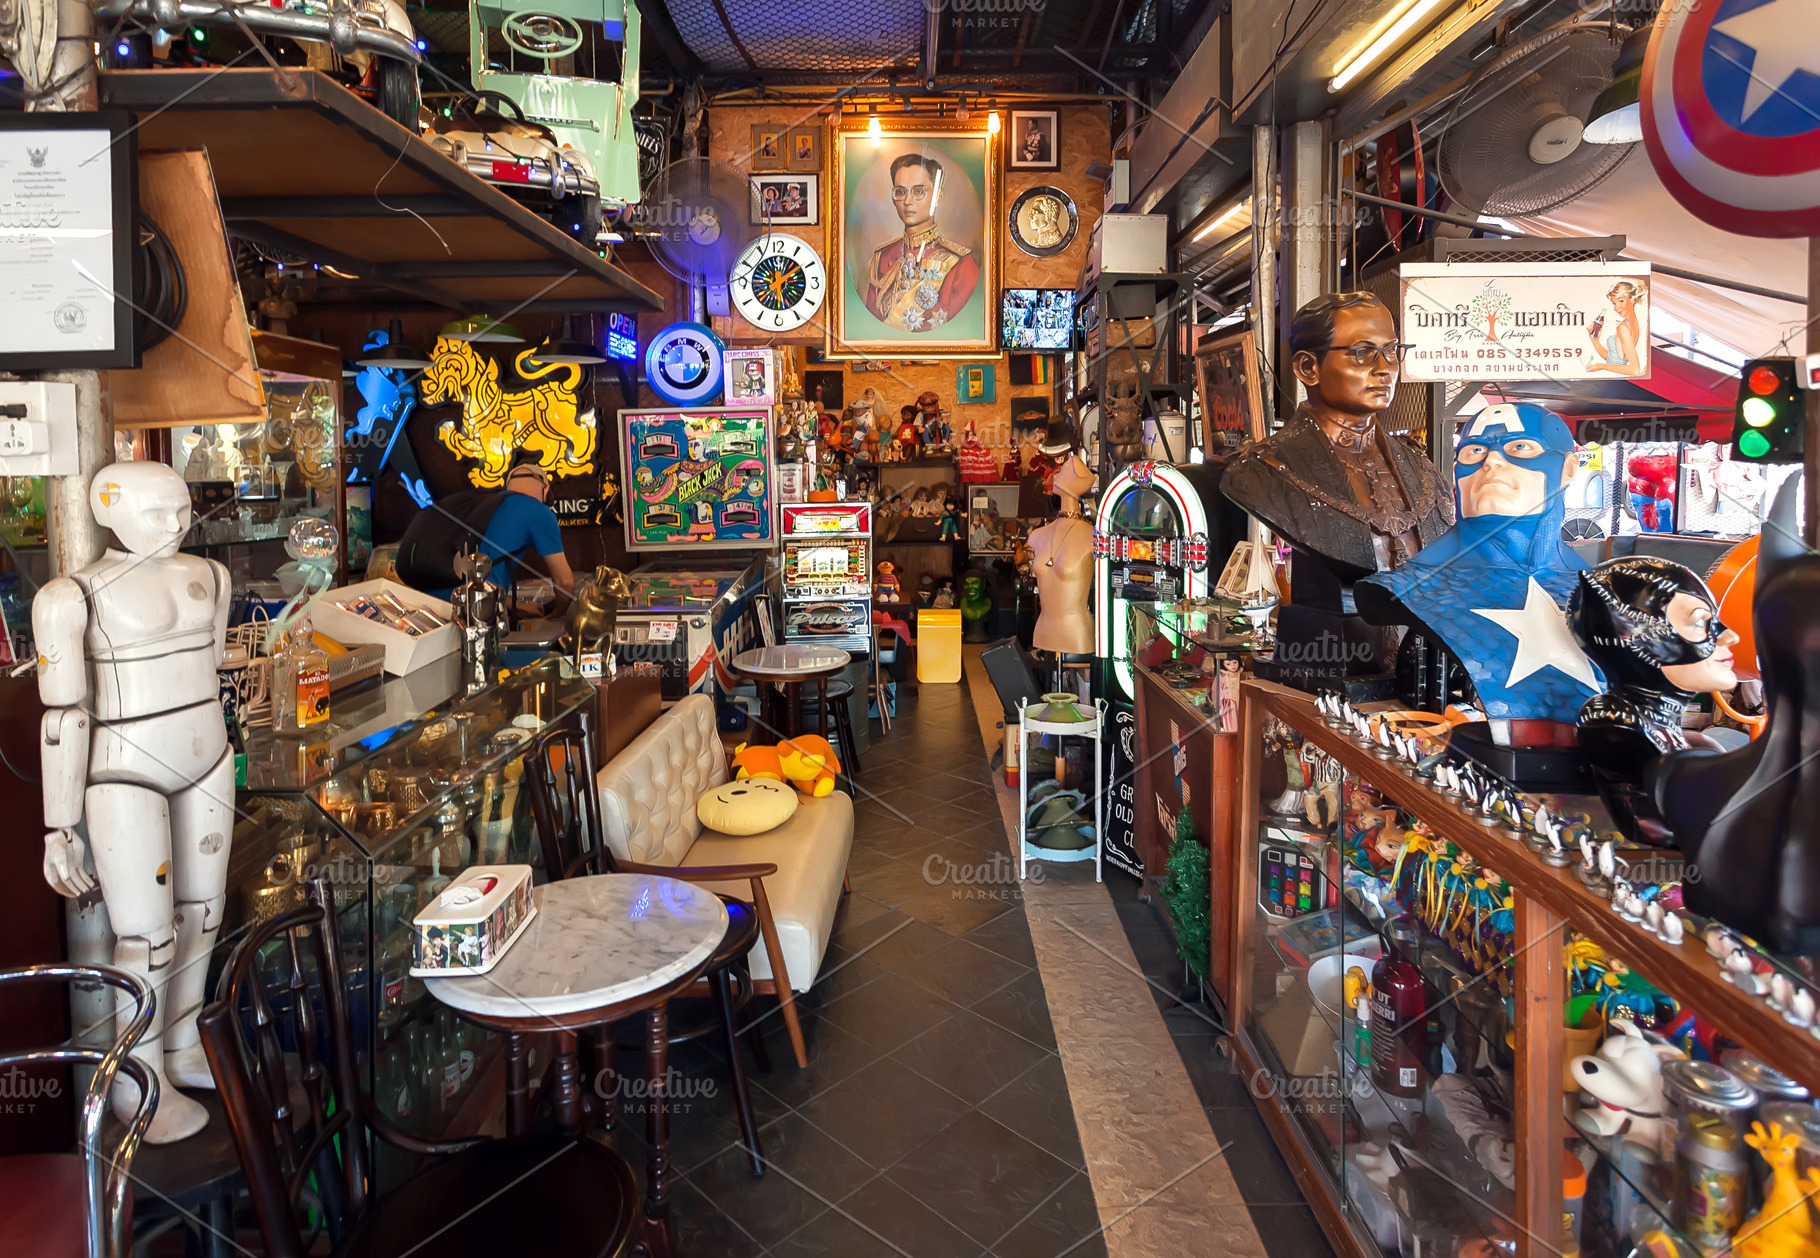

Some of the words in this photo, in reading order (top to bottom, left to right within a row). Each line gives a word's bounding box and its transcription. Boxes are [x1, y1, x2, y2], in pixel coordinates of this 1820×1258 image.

[772, 241, 785, 254] 12
[810, 277, 820, 290] 3
[610, 312, 636, 338] OPEN
[774, 315, 784, 327] 6
[1444, 329, 1463, 343] Big
[1465, 329, 1485, 341] Tree
[1500, 330, 1536, 343] Antique
[1476, 348, 1507, 359] 085
[1515, 347, 1583, 359] 3349559
[678, 476, 702, 503] BLACK
[702, 461, 723, 486] JACK
[1115, 803, 1133, 825] OLD
